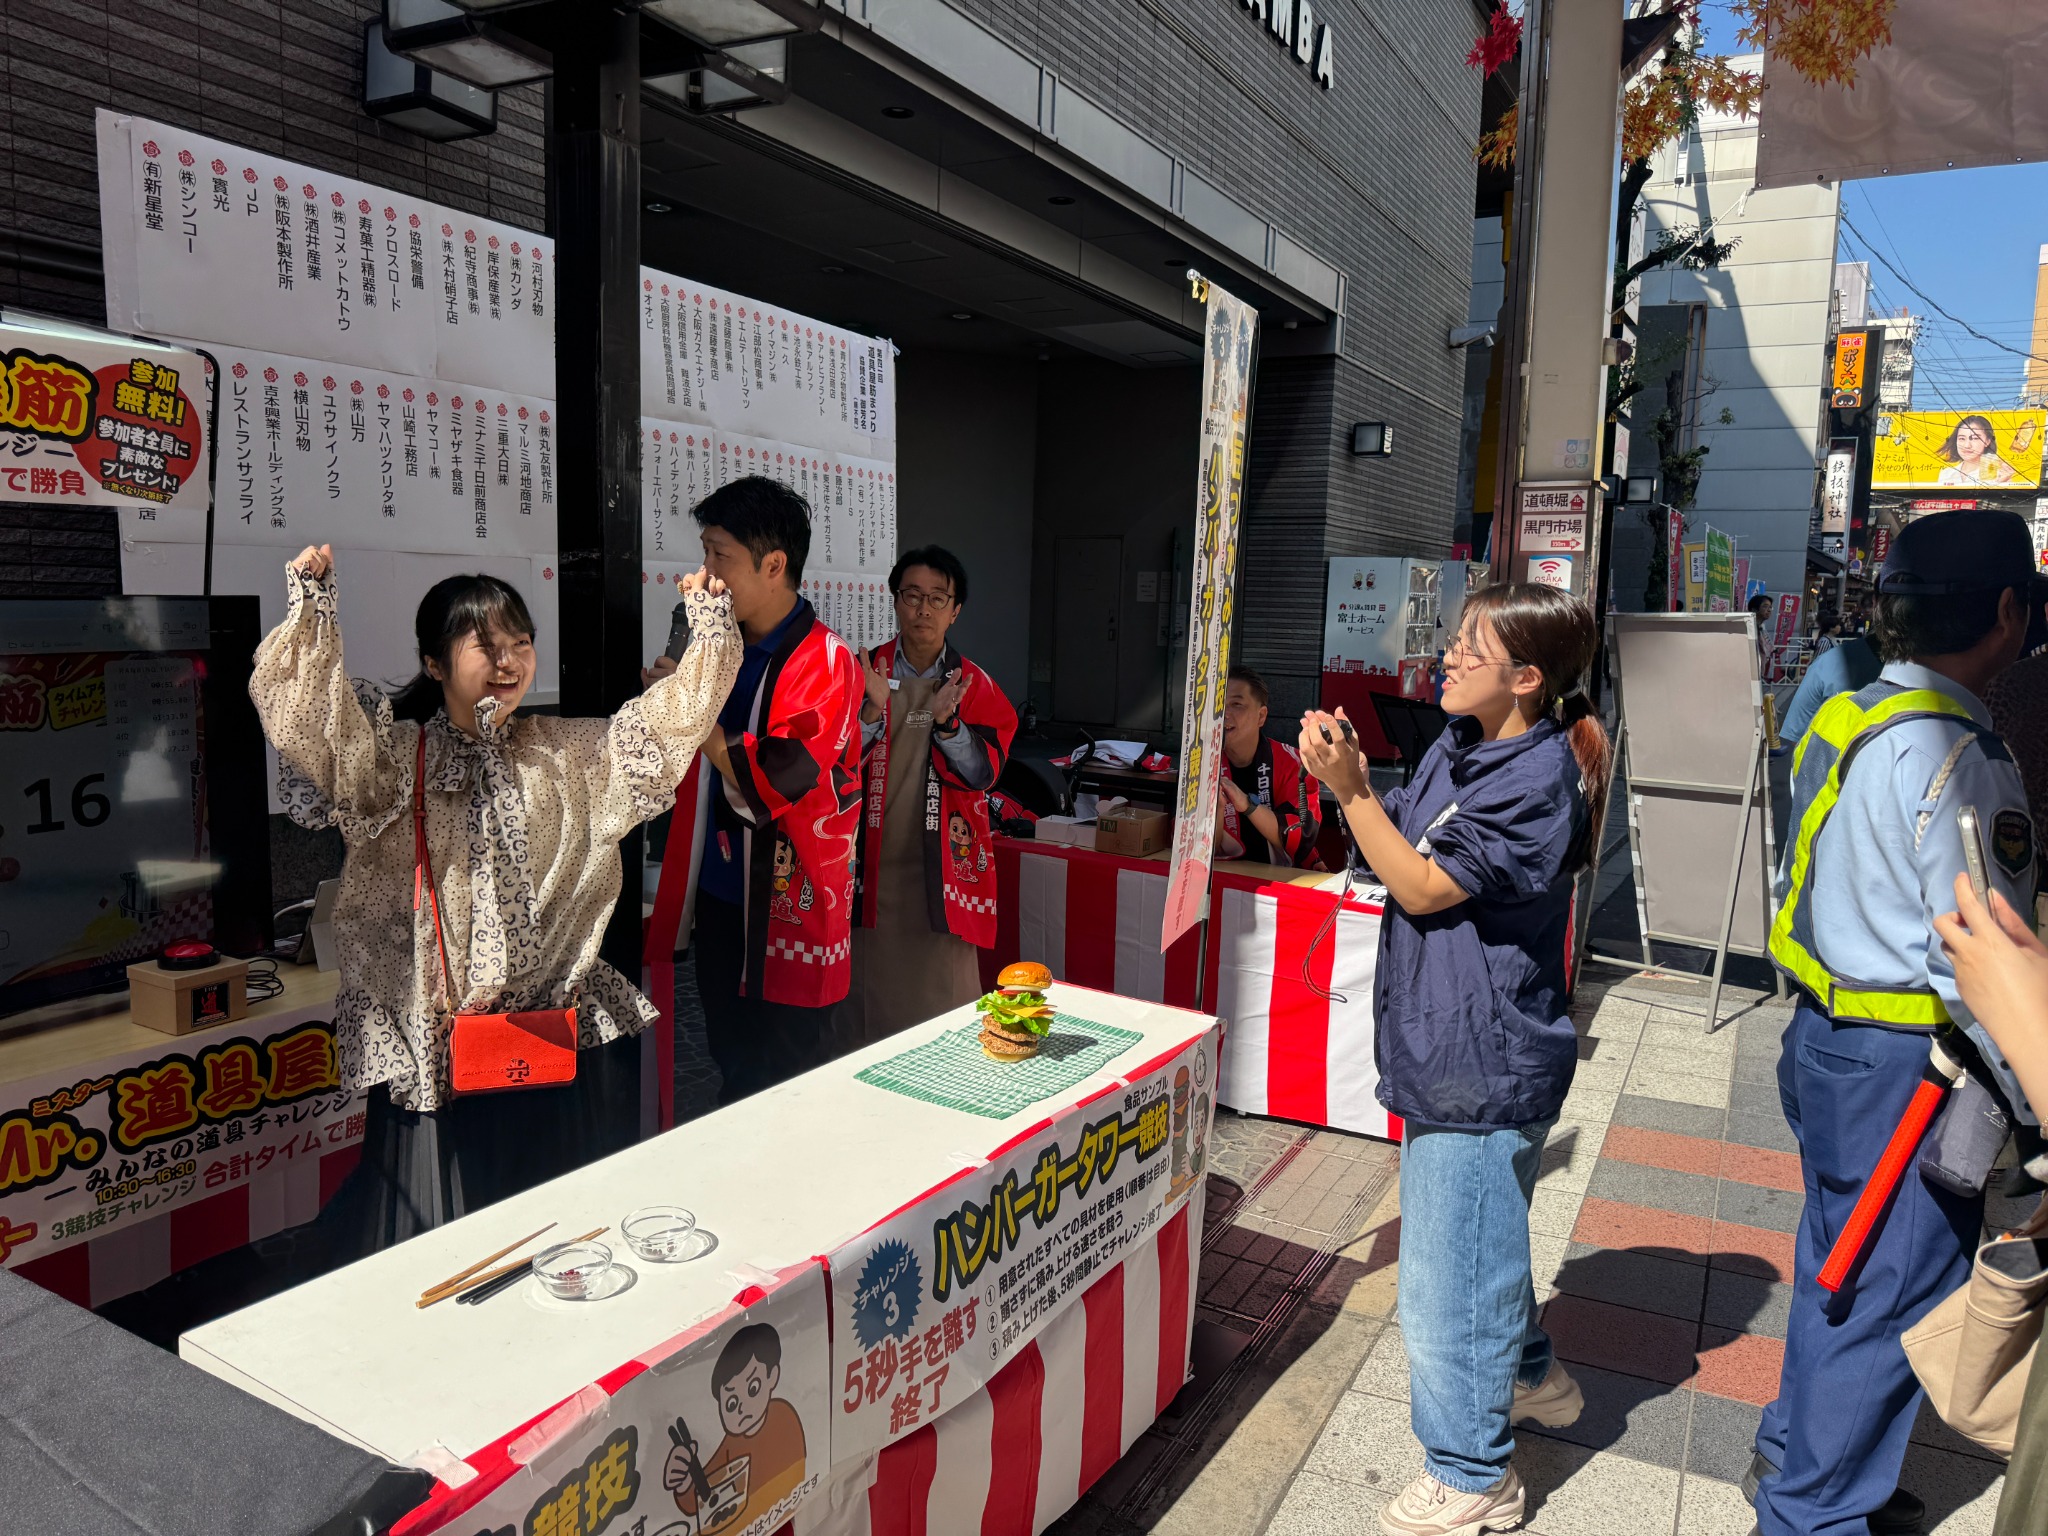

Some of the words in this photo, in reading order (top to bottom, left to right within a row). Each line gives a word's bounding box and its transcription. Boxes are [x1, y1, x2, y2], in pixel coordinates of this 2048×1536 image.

[143, 160, 164, 231] ㈲新星堂
[179, 168, 198, 253] ㈱シンコー
[246, 188, 259, 216] JP
[274, 193, 293, 290] ㈱阪本製作所
[304, 201, 322, 281] ㈱酒井産業
[332, 209, 351, 331] ㈱コメットカトウ
[386, 224, 401, 312] クロスロード
[410, 230, 424, 290] 協栄警備
[510, 256, 522, 310] ㈱カンダ
[532, 262, 543, 316] 河村刃物
[1220, 337, 1225, 357] 3
[1840, 337, 1864, 348] 麻雀
[0, 357, 92, 437] 筋
[115, 383, 185, 426] 無料!
[131, 360, 177, 394] 参加
[98, 418, 189, 459] 参加者全員に
[293, 389, 311, 452] 横山刃物
[350, 397, 365, 442] ㈱山万
[427, 409, 441, 480] ヤマコー㈱
[102, 462, 177, 492] プレゼント!
[119, 446, 166, 471] 素敵な
[233, 381, 254, 525] レストランサプライ
[263, 385, 287, 529] 吉本興業ホールディングス㈱
[451, 413, 463, 496] ミヤザキ食器
[474, 415, 487, 538] ミナミ千日前商店会
[518, 423, 532, 515] マルミ河地商店
[653, 443, 664, 551] フォーエバーサンクス
[1525, 493, 1569, 508] 道頓堀
[1827, 460, 1846, 520] 鉄板神社
[1524, 520, 1582, 535] 黒門市場
[1185, 446, 1223, 816] ハンバーガータワー競技
[1337, 612, 1386, 625] 富士ホーム
[1347, 626, 1375, 635] サービス
[58, 697, 107, 722] チャレン
[33, 1078, 114, 1117] ミスター
[116, 1028, 342, 1148] 道具屋
[1124, 1075, 1168, 1112] 食品サンプル
[51, 1176, 198, 1240] 3競技チャレンジ
[936, 1096, 1168, 1296] ハンバーガータワー競技
[859, 1250, 911, 1312] チャレンジ
[1000, 1212, 1124, 1325] 崩さずに積み上げる速さを競う
[882, 1294, 900, 1328] 3
[843, 1297, 981, 1415] 5秒手を離す
[889, 1363, 950, 1436] 終了
